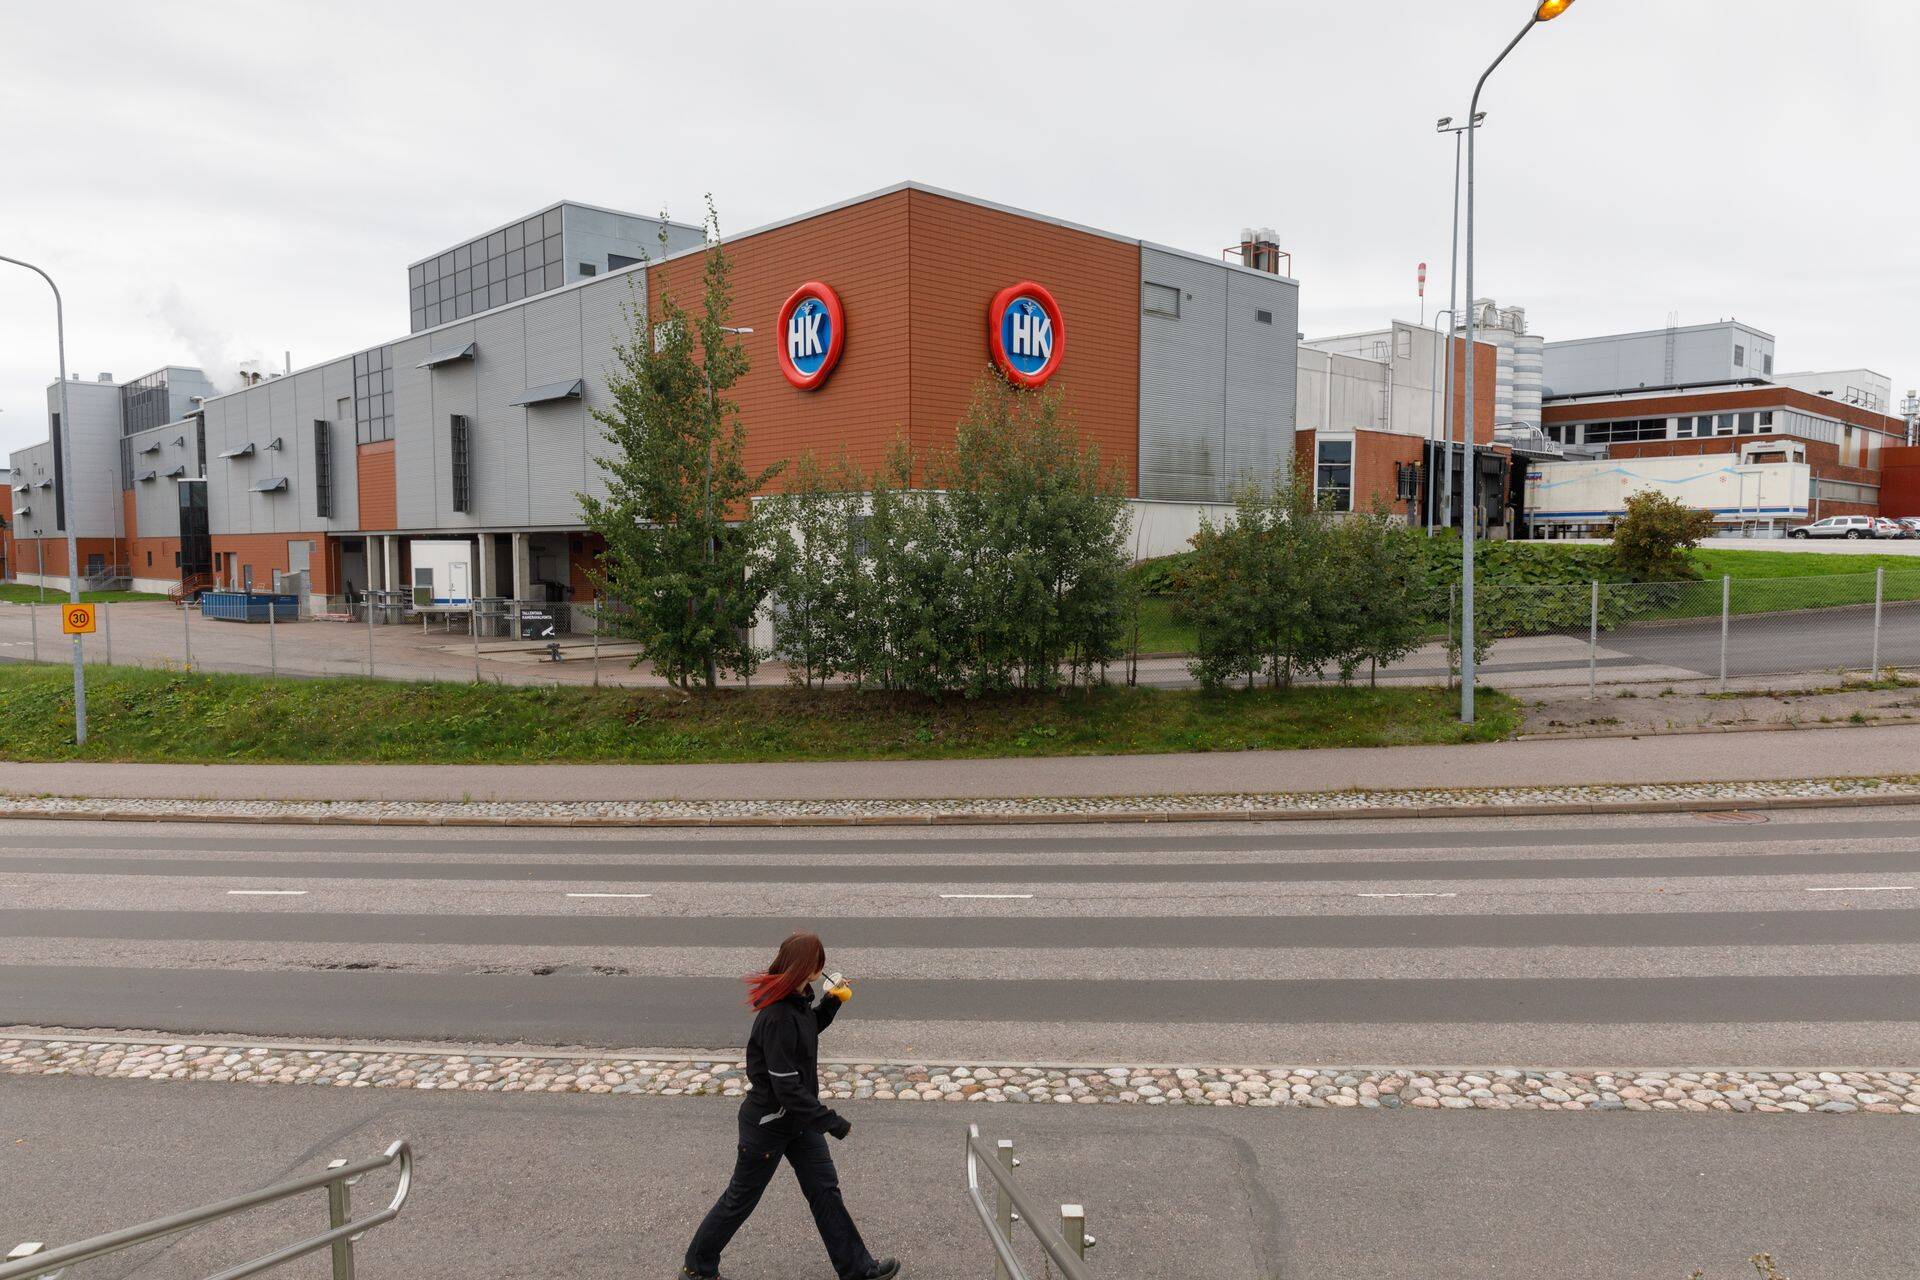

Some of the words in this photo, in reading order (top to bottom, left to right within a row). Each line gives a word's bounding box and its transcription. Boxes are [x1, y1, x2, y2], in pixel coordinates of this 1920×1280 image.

[788, 313, 822, 359] HK
[1013, 312, 1051, 358] HK
[73, 613, 86, 623] 30
